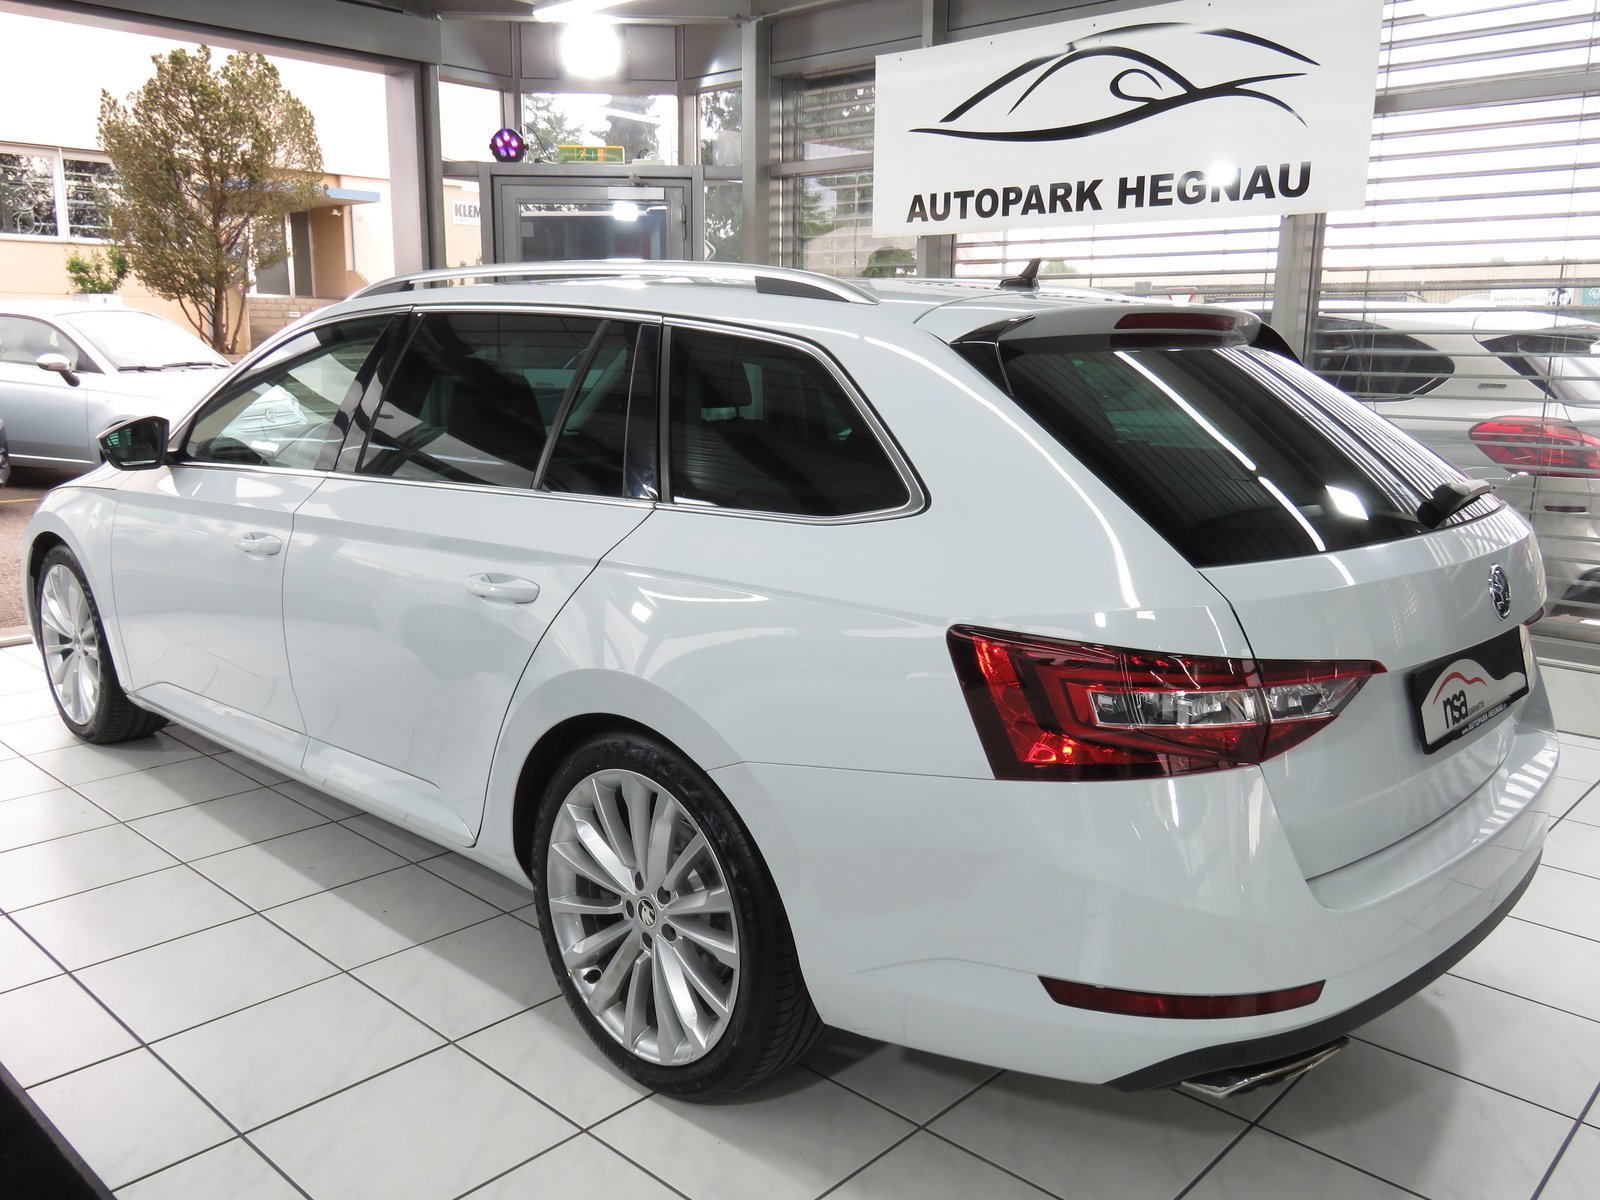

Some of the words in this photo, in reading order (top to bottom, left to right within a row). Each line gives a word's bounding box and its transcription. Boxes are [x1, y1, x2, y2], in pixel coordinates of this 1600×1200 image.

[906, 179, 1104, 223] AUTOPARK
[1118, 161, 1312, 209] HEGNAU
[1442, 689, 1469, 729] nsa
